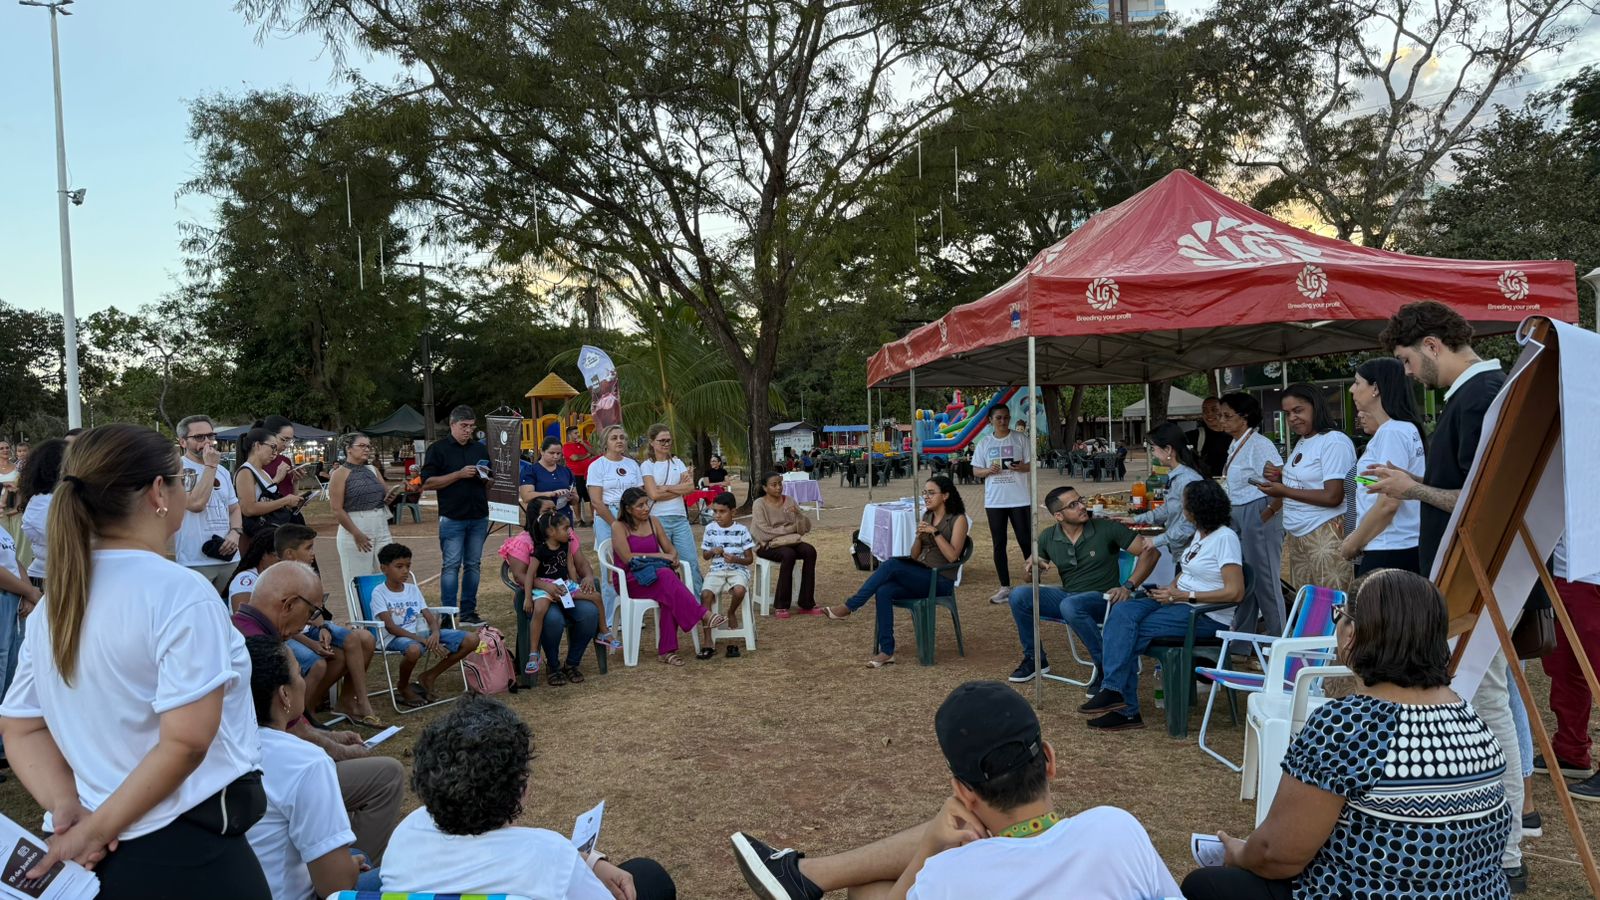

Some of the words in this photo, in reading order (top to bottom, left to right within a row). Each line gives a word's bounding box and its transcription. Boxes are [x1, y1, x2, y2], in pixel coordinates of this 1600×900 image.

[1215, 235, 1282, 260] LG
[1306, 275, 1319, 289] LG
[1507, 278, 1521, 291] LG
[1096, 286, 1110, 301] LG
[1488, 303, 1513, 311] Breeding
[1102, 314, 1116, 322] your
[20, 852, 38, 871] Junho
